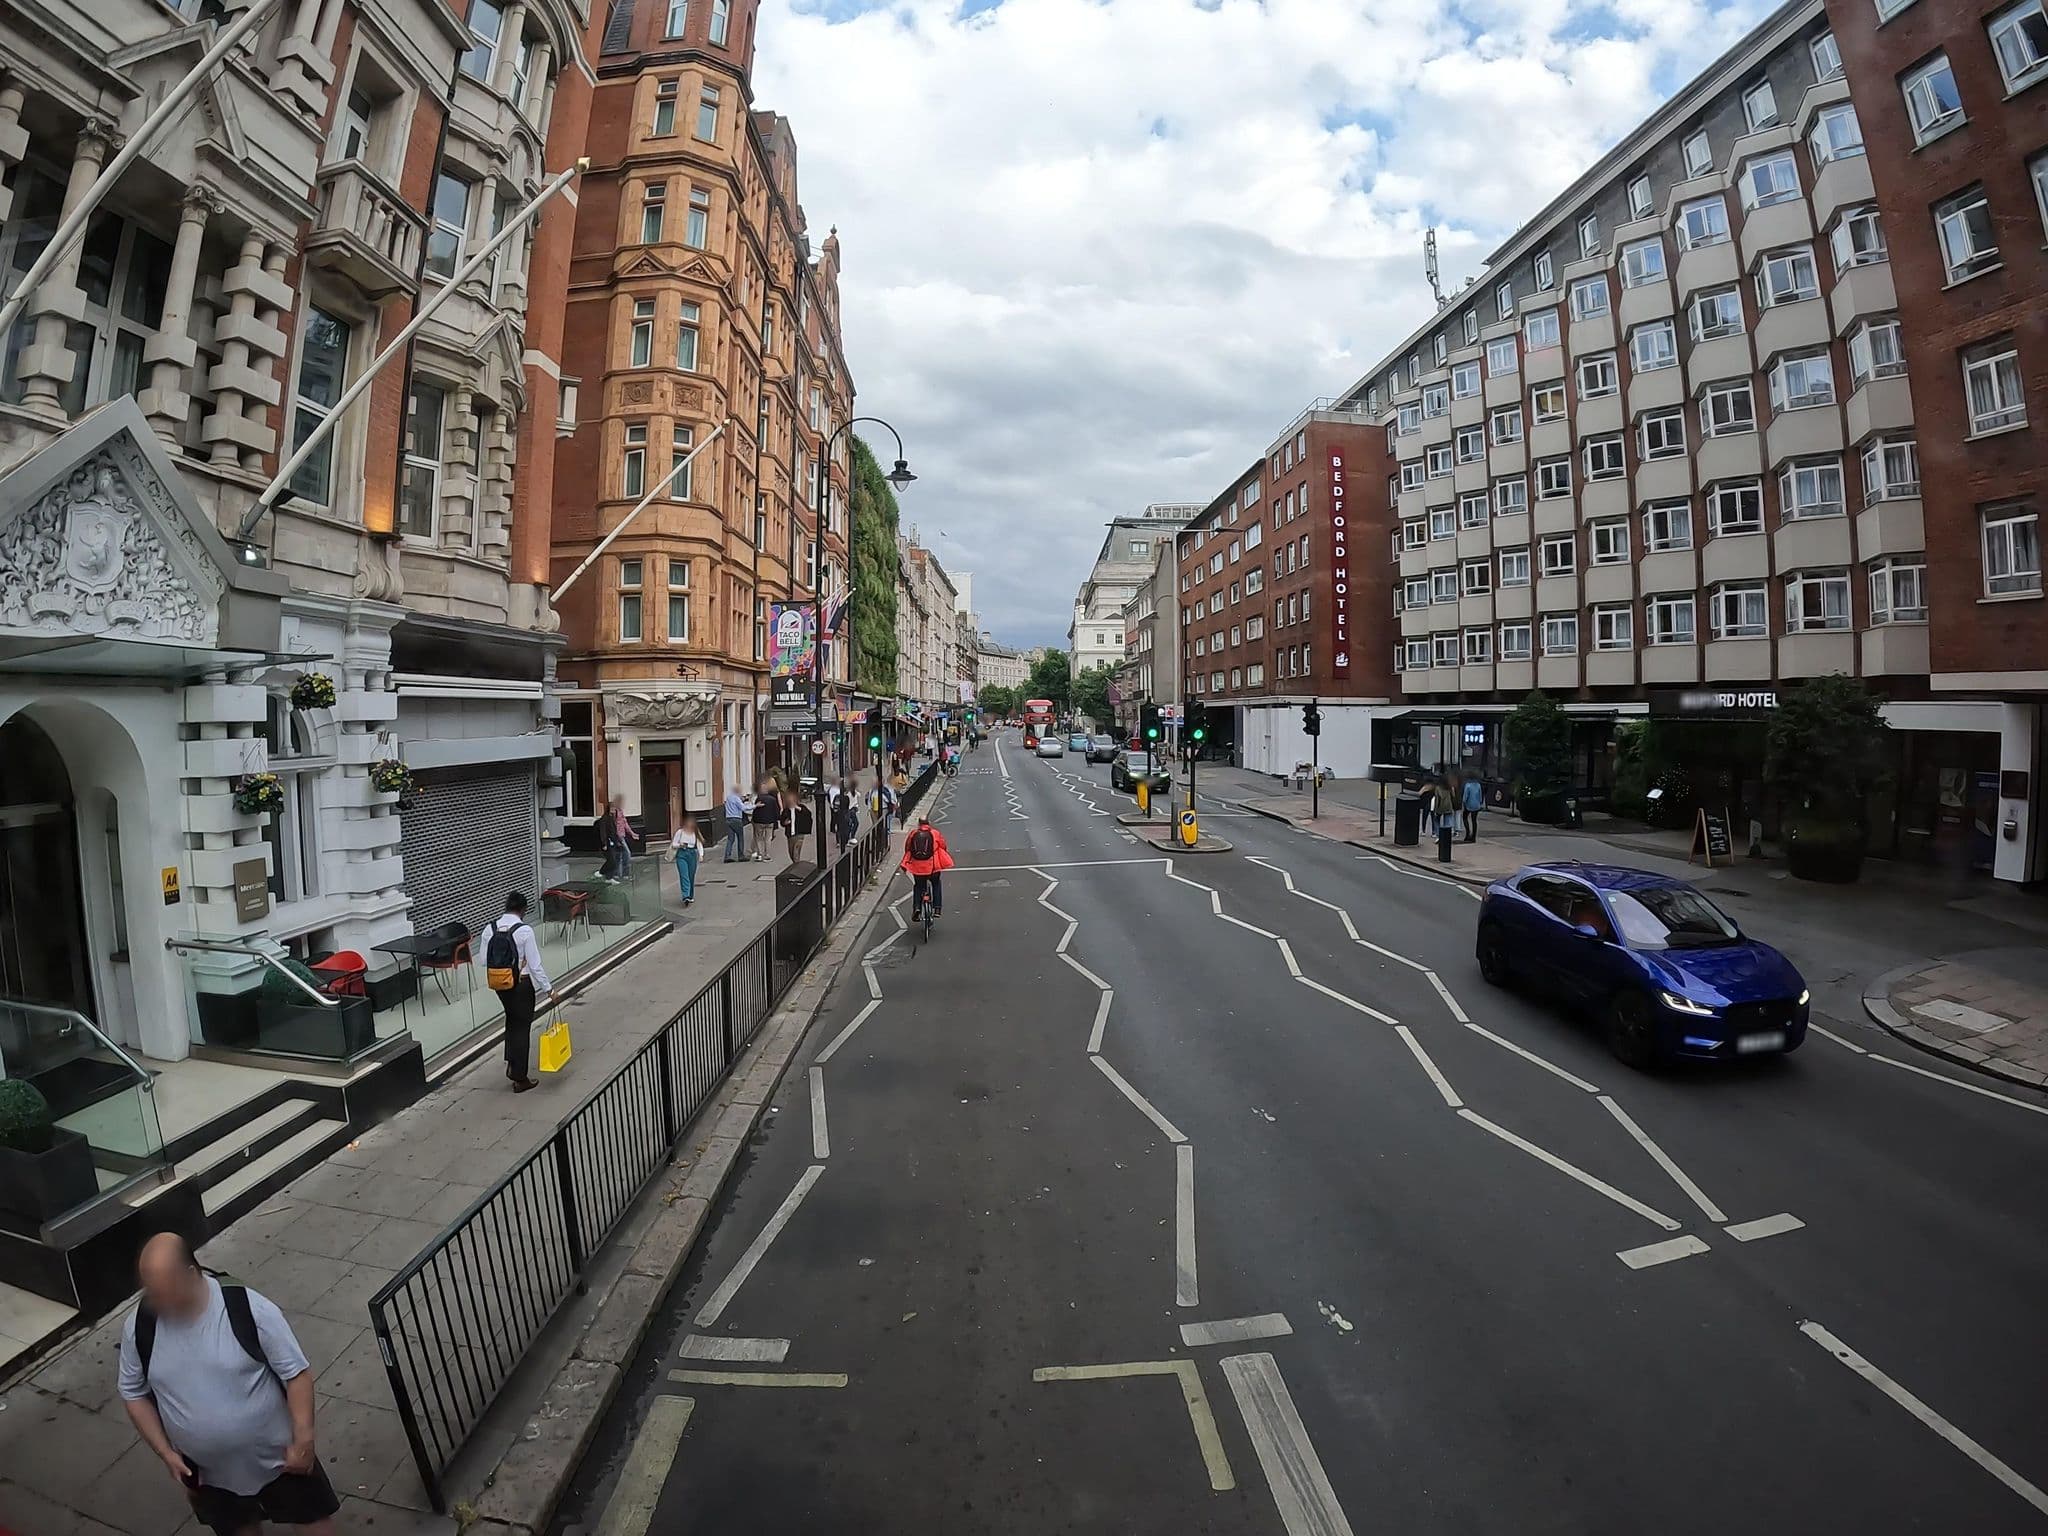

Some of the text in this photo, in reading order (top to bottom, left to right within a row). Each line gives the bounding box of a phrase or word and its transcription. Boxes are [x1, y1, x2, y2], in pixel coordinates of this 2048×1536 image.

[1332, 456, 1347, 641] BEDFORD HOTEL
[790, 693, 805, 701] WALK
[1738, 692, 1779, 708] HOTEL
[813, 743, 823, 751] 20
[166, 873, 177, 888] AA
